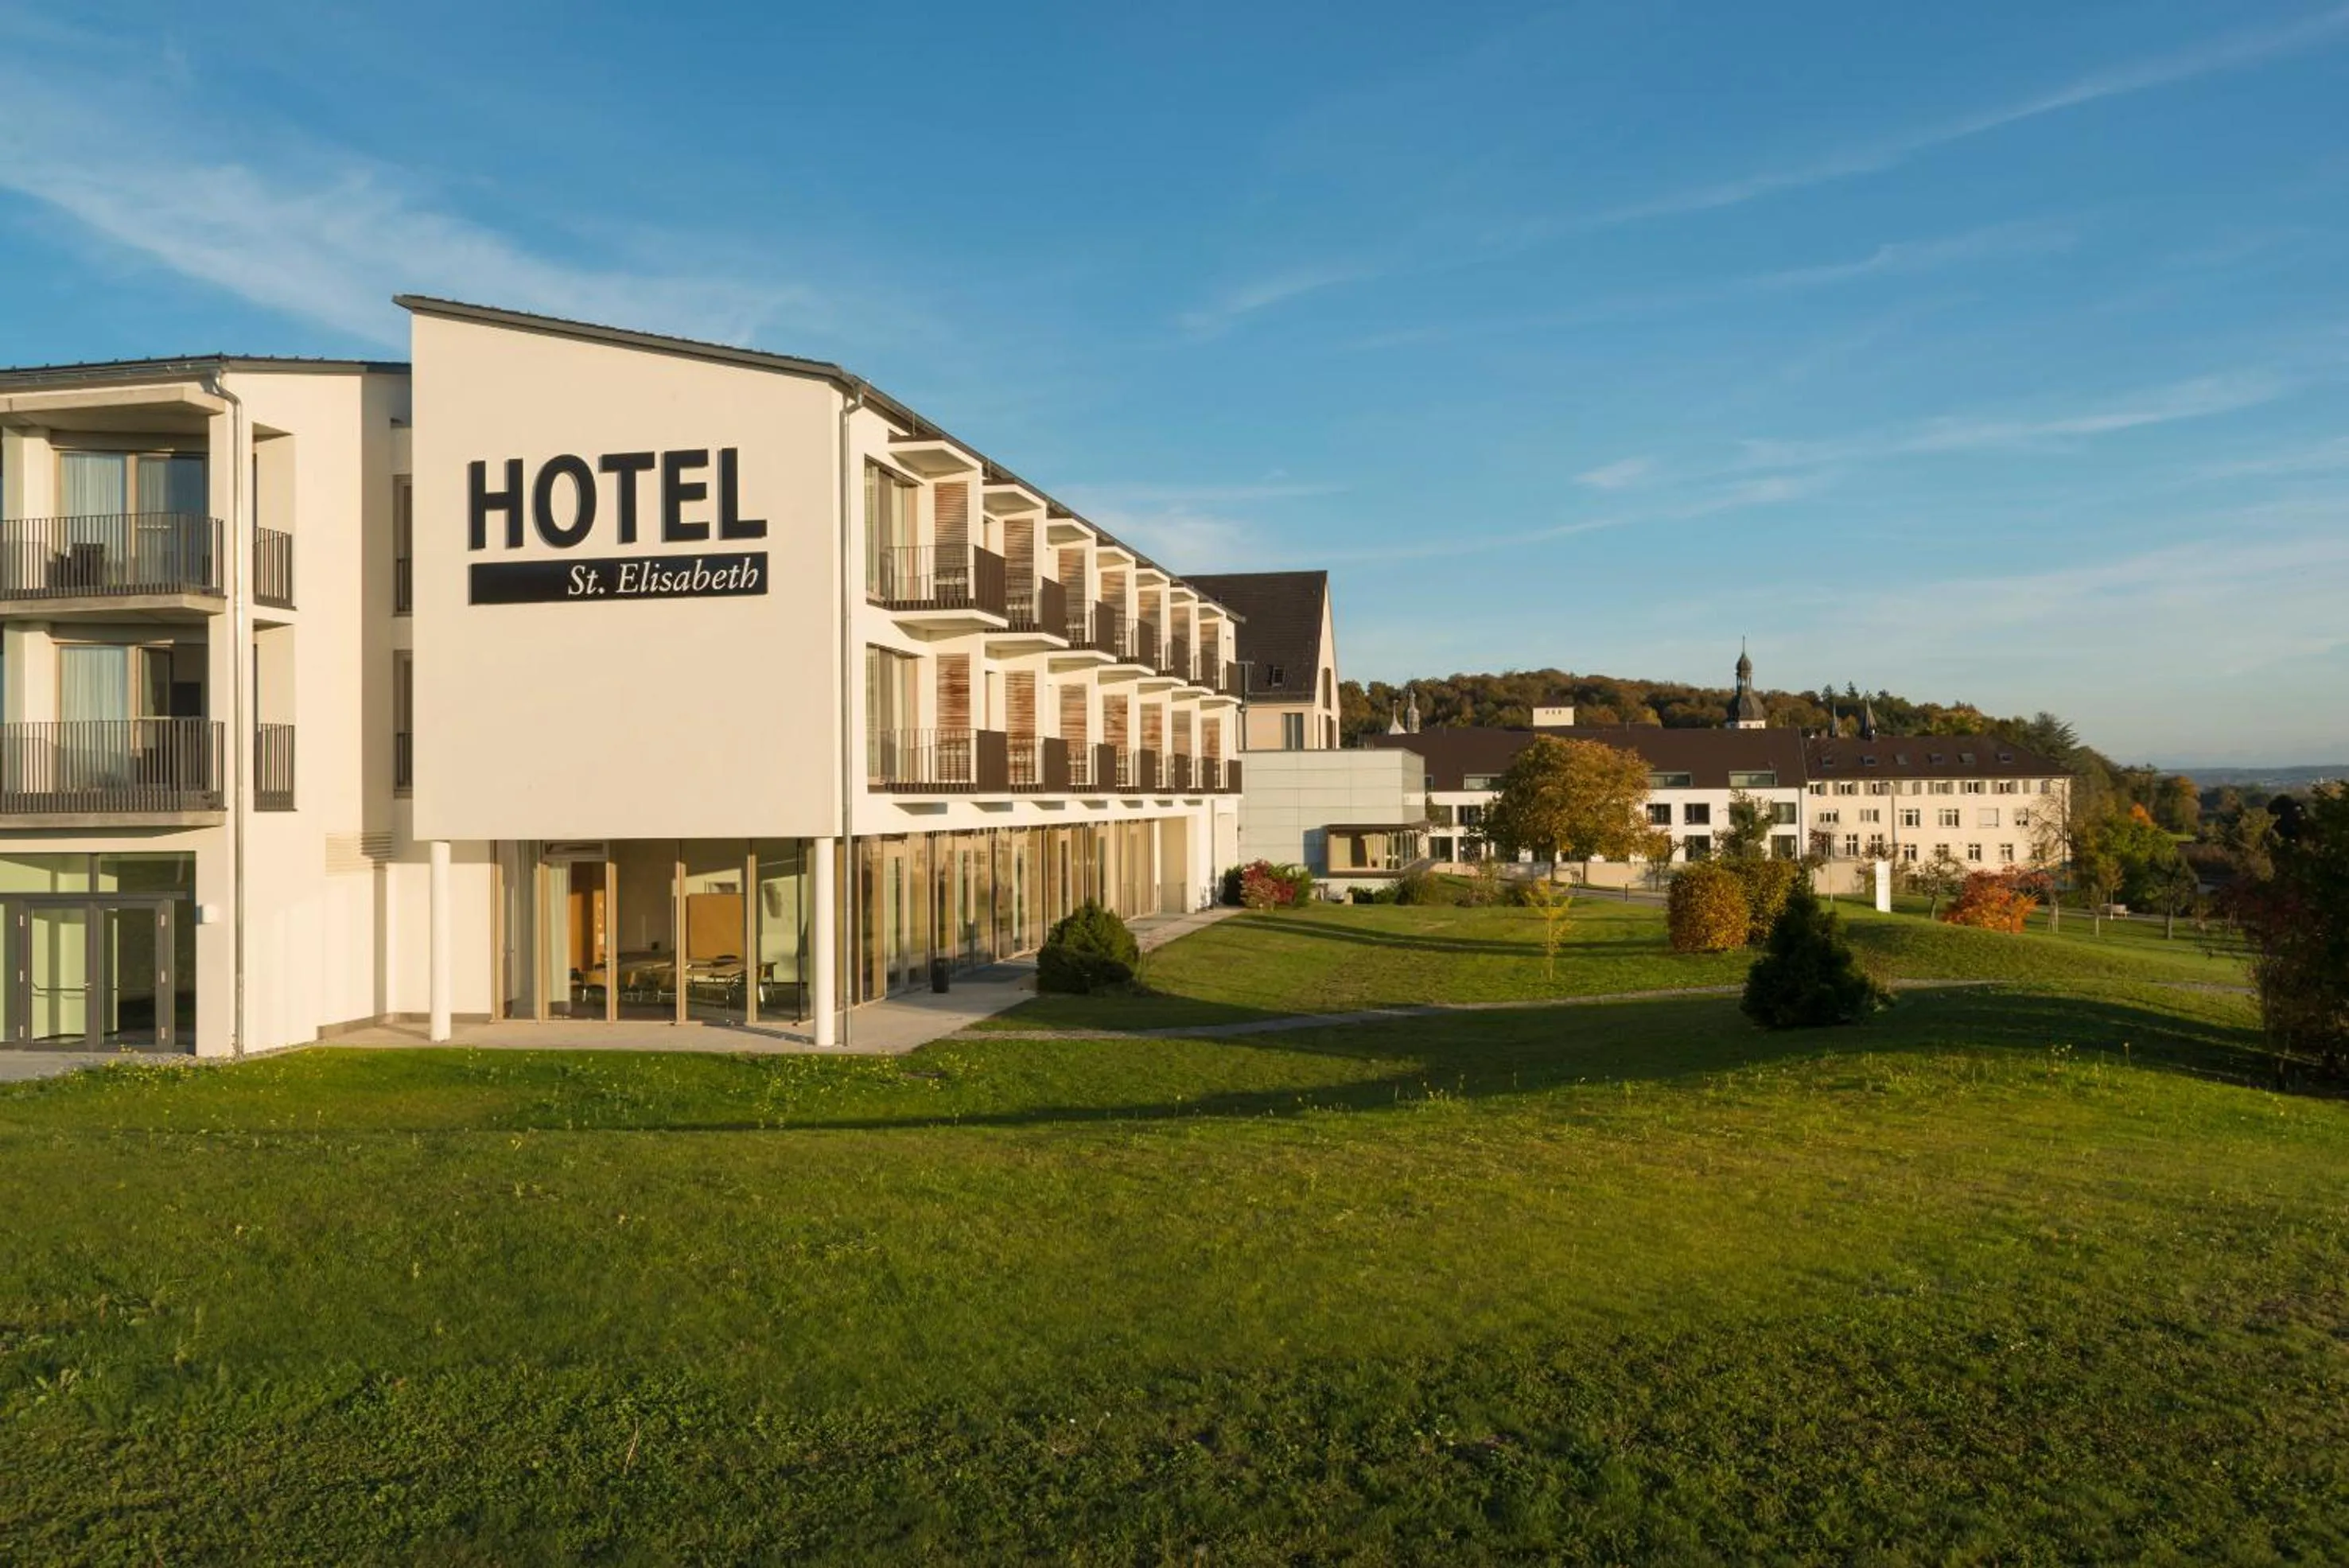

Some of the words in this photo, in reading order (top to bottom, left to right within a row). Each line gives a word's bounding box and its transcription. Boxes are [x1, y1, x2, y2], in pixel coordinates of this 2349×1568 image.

[468, 447, 767, 551] HOTEL
[568, 565, 605, 595] St.
[616, 557, 759, 594] Elisabeth
